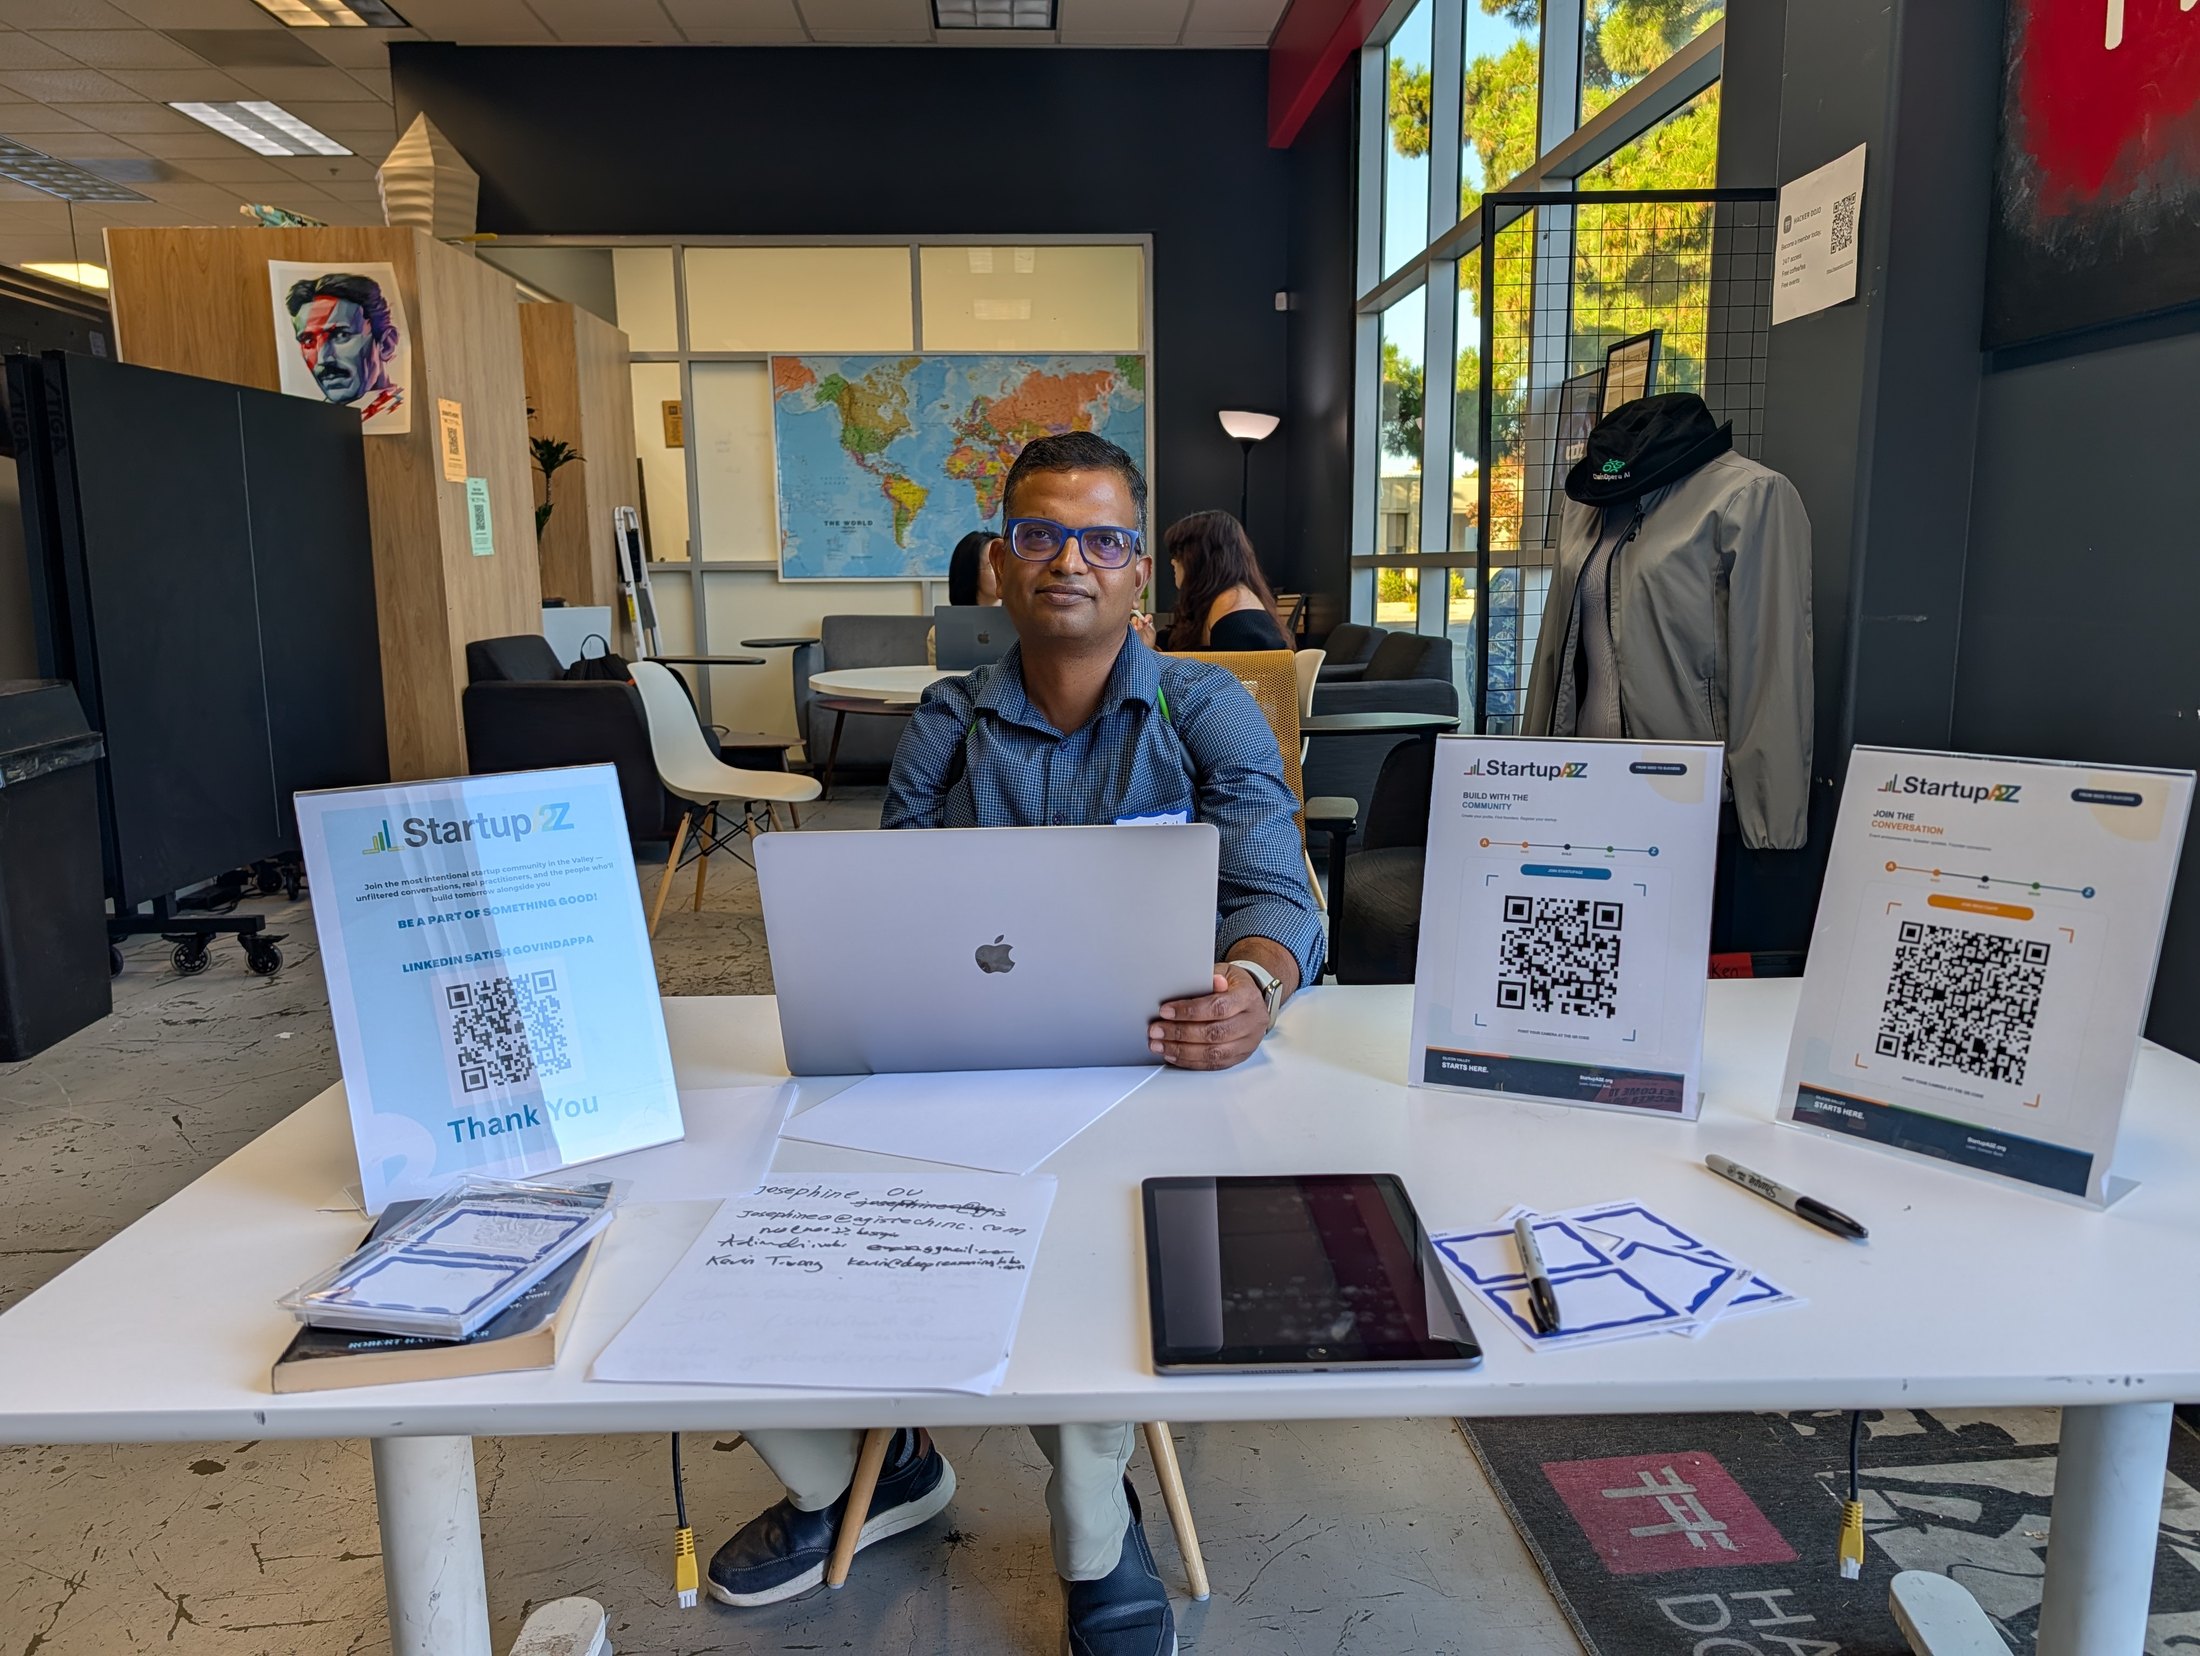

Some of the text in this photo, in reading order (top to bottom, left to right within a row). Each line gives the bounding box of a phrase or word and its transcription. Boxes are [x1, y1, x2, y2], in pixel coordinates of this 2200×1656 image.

[1462, 802, 1512, 810] COMMUNITY
[1463, 792, 1488, 800] BUILD
[1489, 793, 1510, 801] WITH
[1873, 809, 1915, 821] JOIN THE
[1871, 820, 1944, 835] CONVERSATION
[355, 862, 614, 902] unfiltered conversations, real practitioners, and the people who'll
[364, 882, 383, 891] Join
[385, 879, 399, 888] the
[401, 877, 423, 886] most
[424, 871, 470, 883] intentional
[471, 867, 500, 878] startup
[502, 861, 547, 874] community
[548, 859, 556, 867] in
[556, 857, 570, 866] the
[571, 855, 594, 865] Valley
[431, 880, 551, 903] build tomorrow alongside you
[397, 893, 598, 929] BE A PART OF SOMETHING GOOD!
[402, 935, 594, 973] LINKEDIN SATISH GOVINDAPPA
[1441, 1061, 1489, 1073] STARTS HERE.
[447, 1095, 599, 1143] Thank You
[1814, 1101, 1864, 1119] STARTS HERE.
